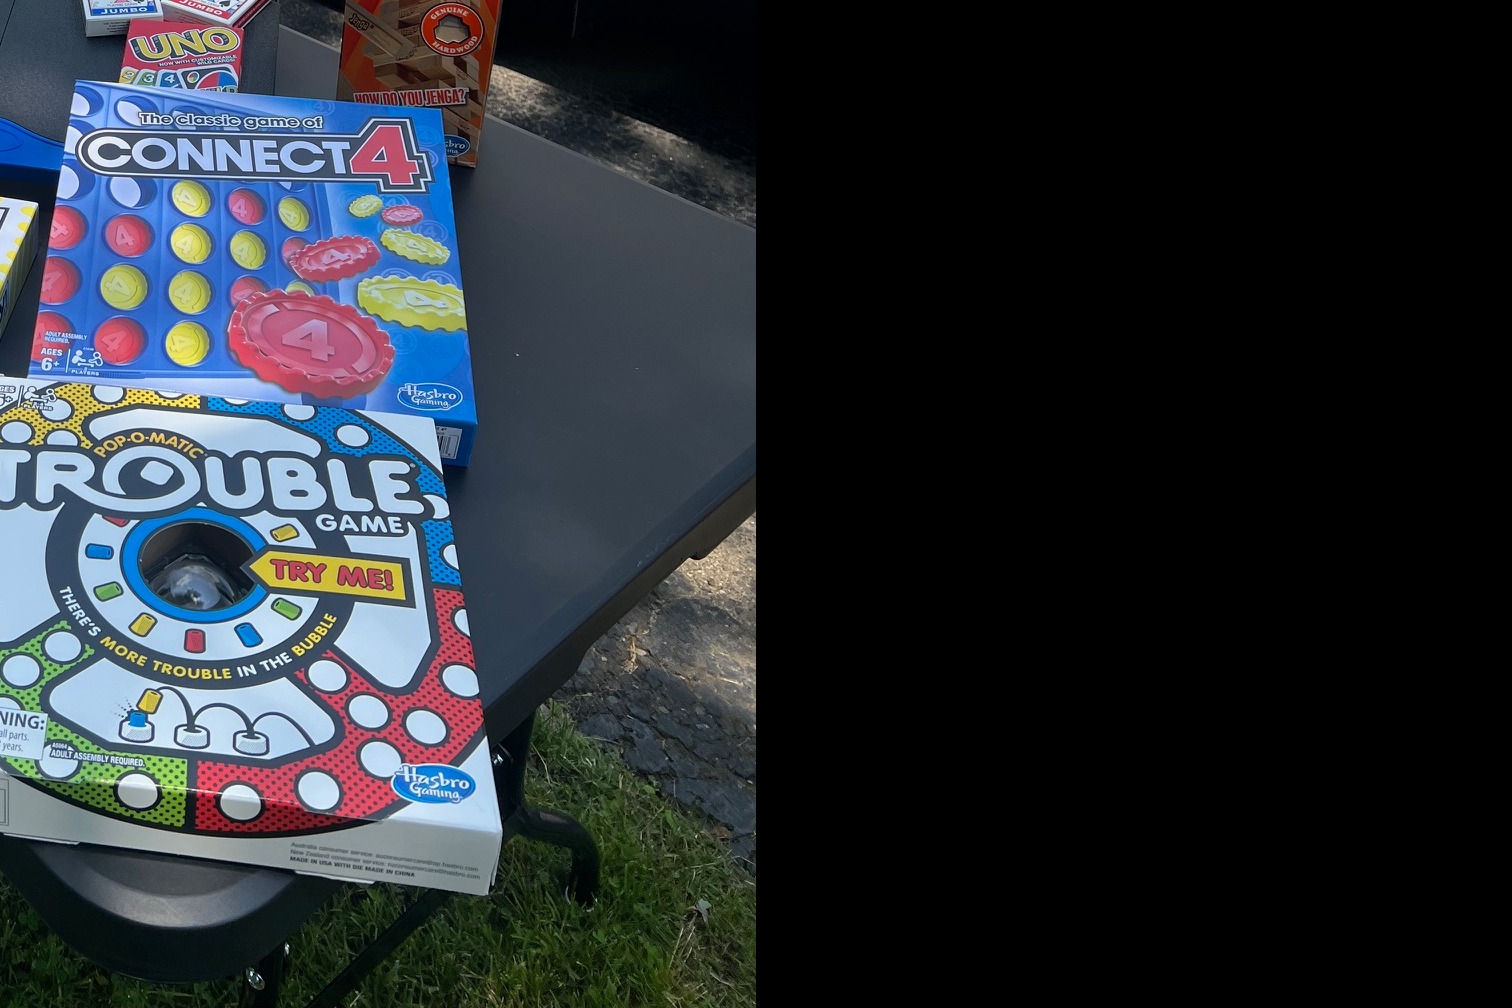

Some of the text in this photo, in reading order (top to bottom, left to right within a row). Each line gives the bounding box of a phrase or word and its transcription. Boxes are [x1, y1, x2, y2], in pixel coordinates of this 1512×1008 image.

[101, 7, 148, 15] JUMBO
[179, 0, 223, 15] JUMBO
[430, 7, 469, 20] GENUINE
[133, 28, 238, 60] UNO
[432, 36, 478, 54] HARDWOOD
[191, 54, 237, 62] CUSTOMIZABLE
[122, 70, 135, 80] 2
[143, 74, 155, 83] 3
[164, 74, 176, 83] 4
[354, 88, 465, 106] HOW DO YOU JENGA?
[138, 112, 324, 130] The classic game of
[444, 140, 466, 149] sbro
[88, 124, 420, 186] CONNECT 4
[282, 319, 335, 361] 4
[41, 348, 62, 356] AGES
[41, 358, 59, 371] 6+
[401, 385, 457, 400] Hasbro
[23, 403, 53, 411] PLAYERS
[411, 396, 449, 408] Gaming
[93, 432, 205, 459] POP-O-MATIC
[316, 515, 405, 535] GAME
[270, 558, 394, 591] TRY ME!
[59, 586, 338, 680] THERE'S MORE TROUBLE IN THE BUBBLE
[8, 731, 29, 742] parts.
[2, 742, 23, 752] years.
[51, 749, 145, 767] ADULT ASSEMBLY REQUIRED.
[396, 766, 470, 789] Hasbro
[410, 781, 460, 803] Gaming
[290, 848, 305, 856] New
[305, 850, 330, 859] Zealand
[331, 855, 361, 863] consumer
[291, 842, 318, 851] Australia
[318, 846, 349, 854] consumer
[289, 856, 309, 864] MADE
[394, 870, 415, 878] CHINA
